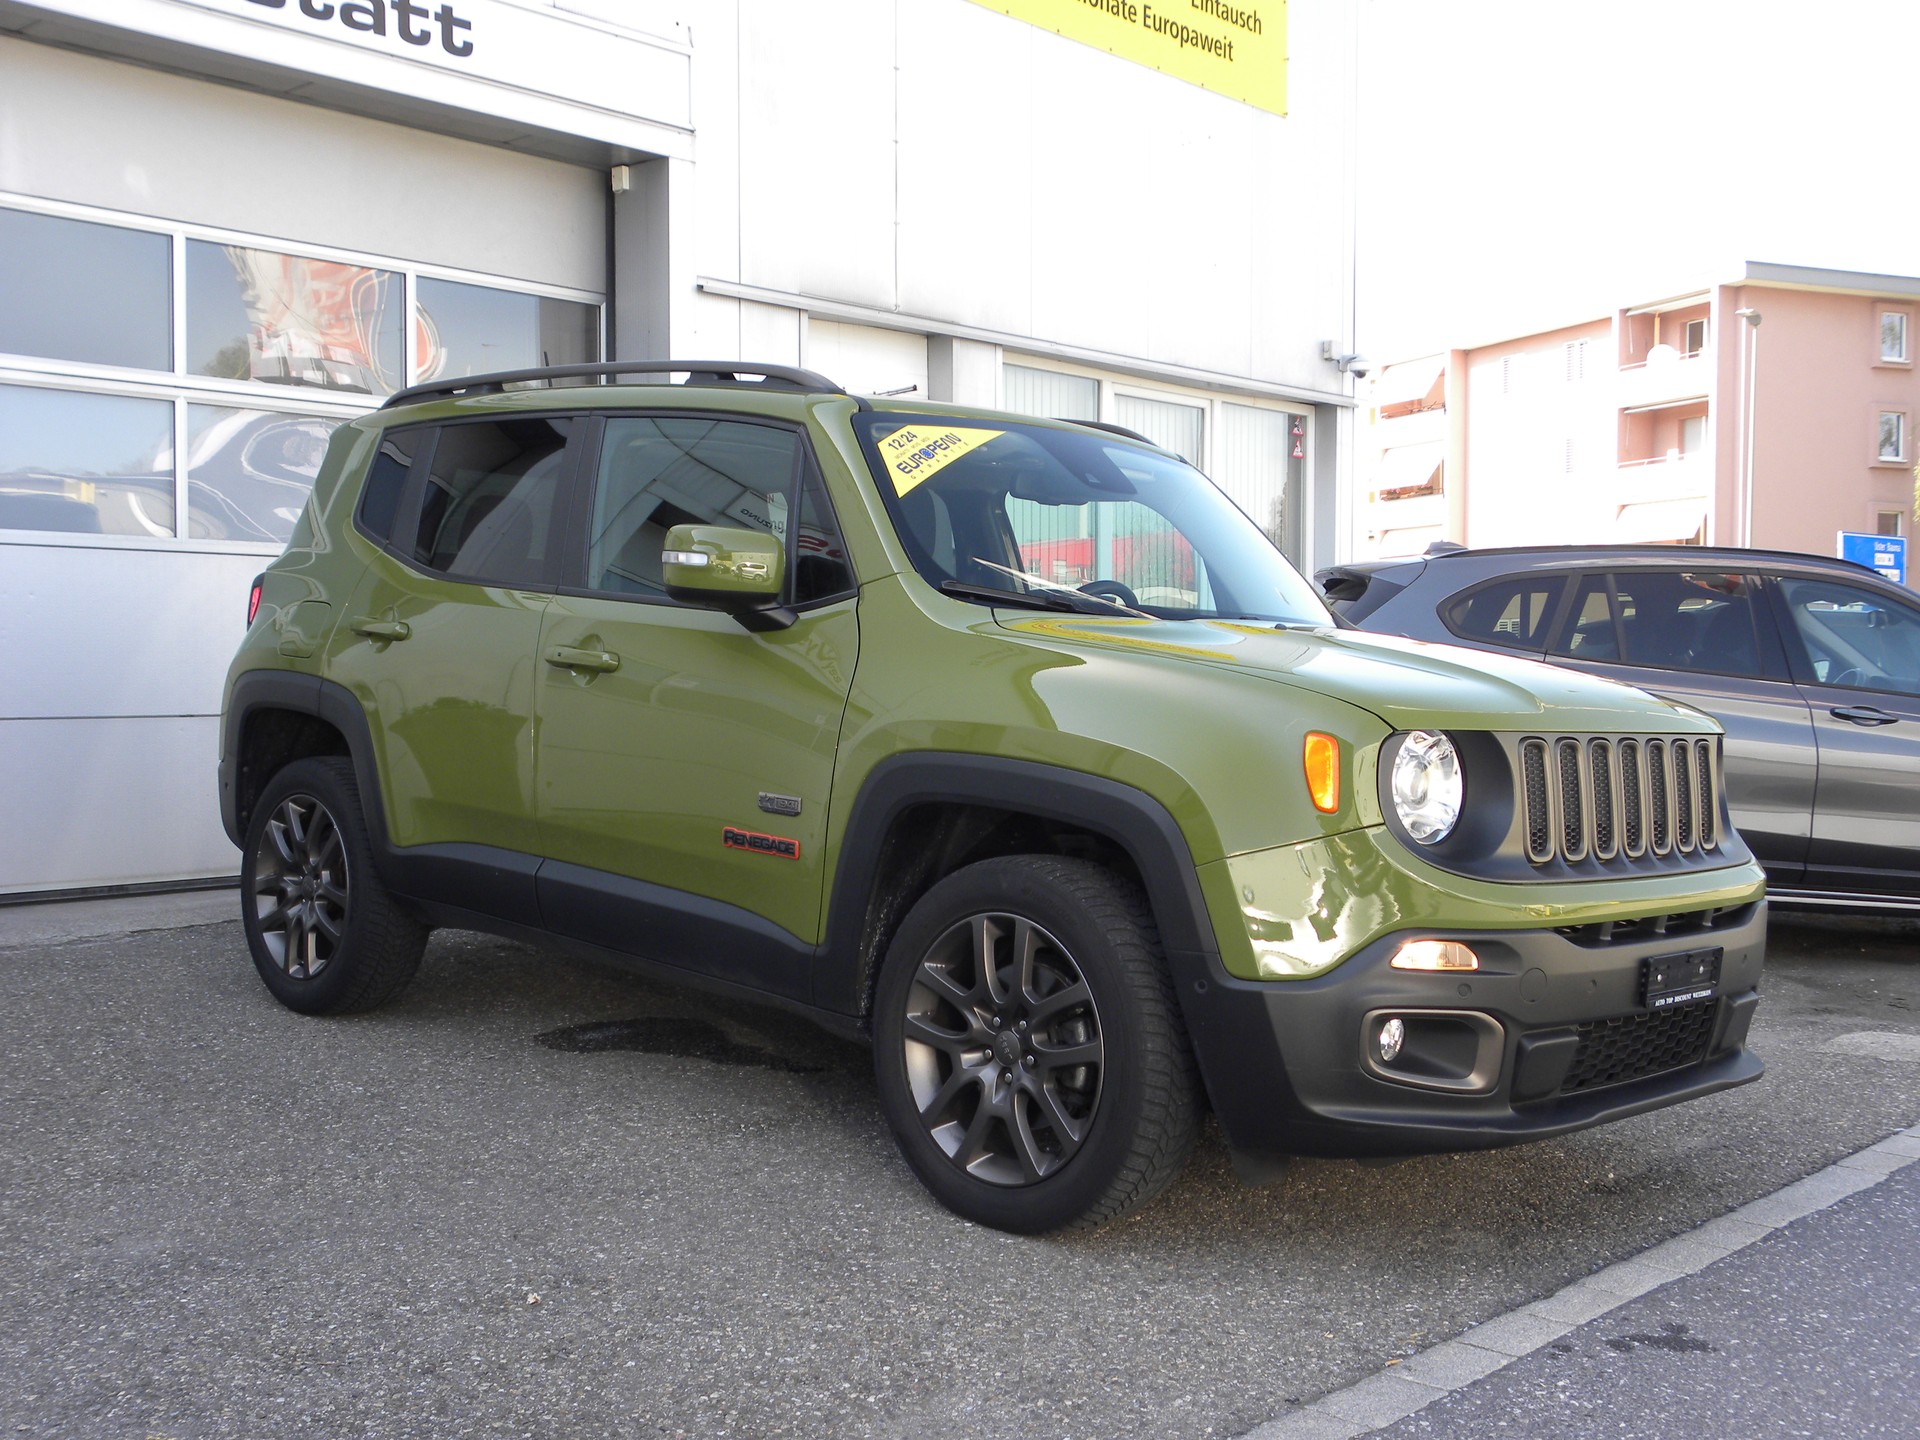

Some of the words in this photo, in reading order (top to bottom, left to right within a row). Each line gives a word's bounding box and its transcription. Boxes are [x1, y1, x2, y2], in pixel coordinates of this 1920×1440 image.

[245, 0, 474, 57] att
[1077, 0, 1137, 23] nate
[1143, 4, 1234, 62] Europaweit
[723, 829, 797, 858] RENEGADE
